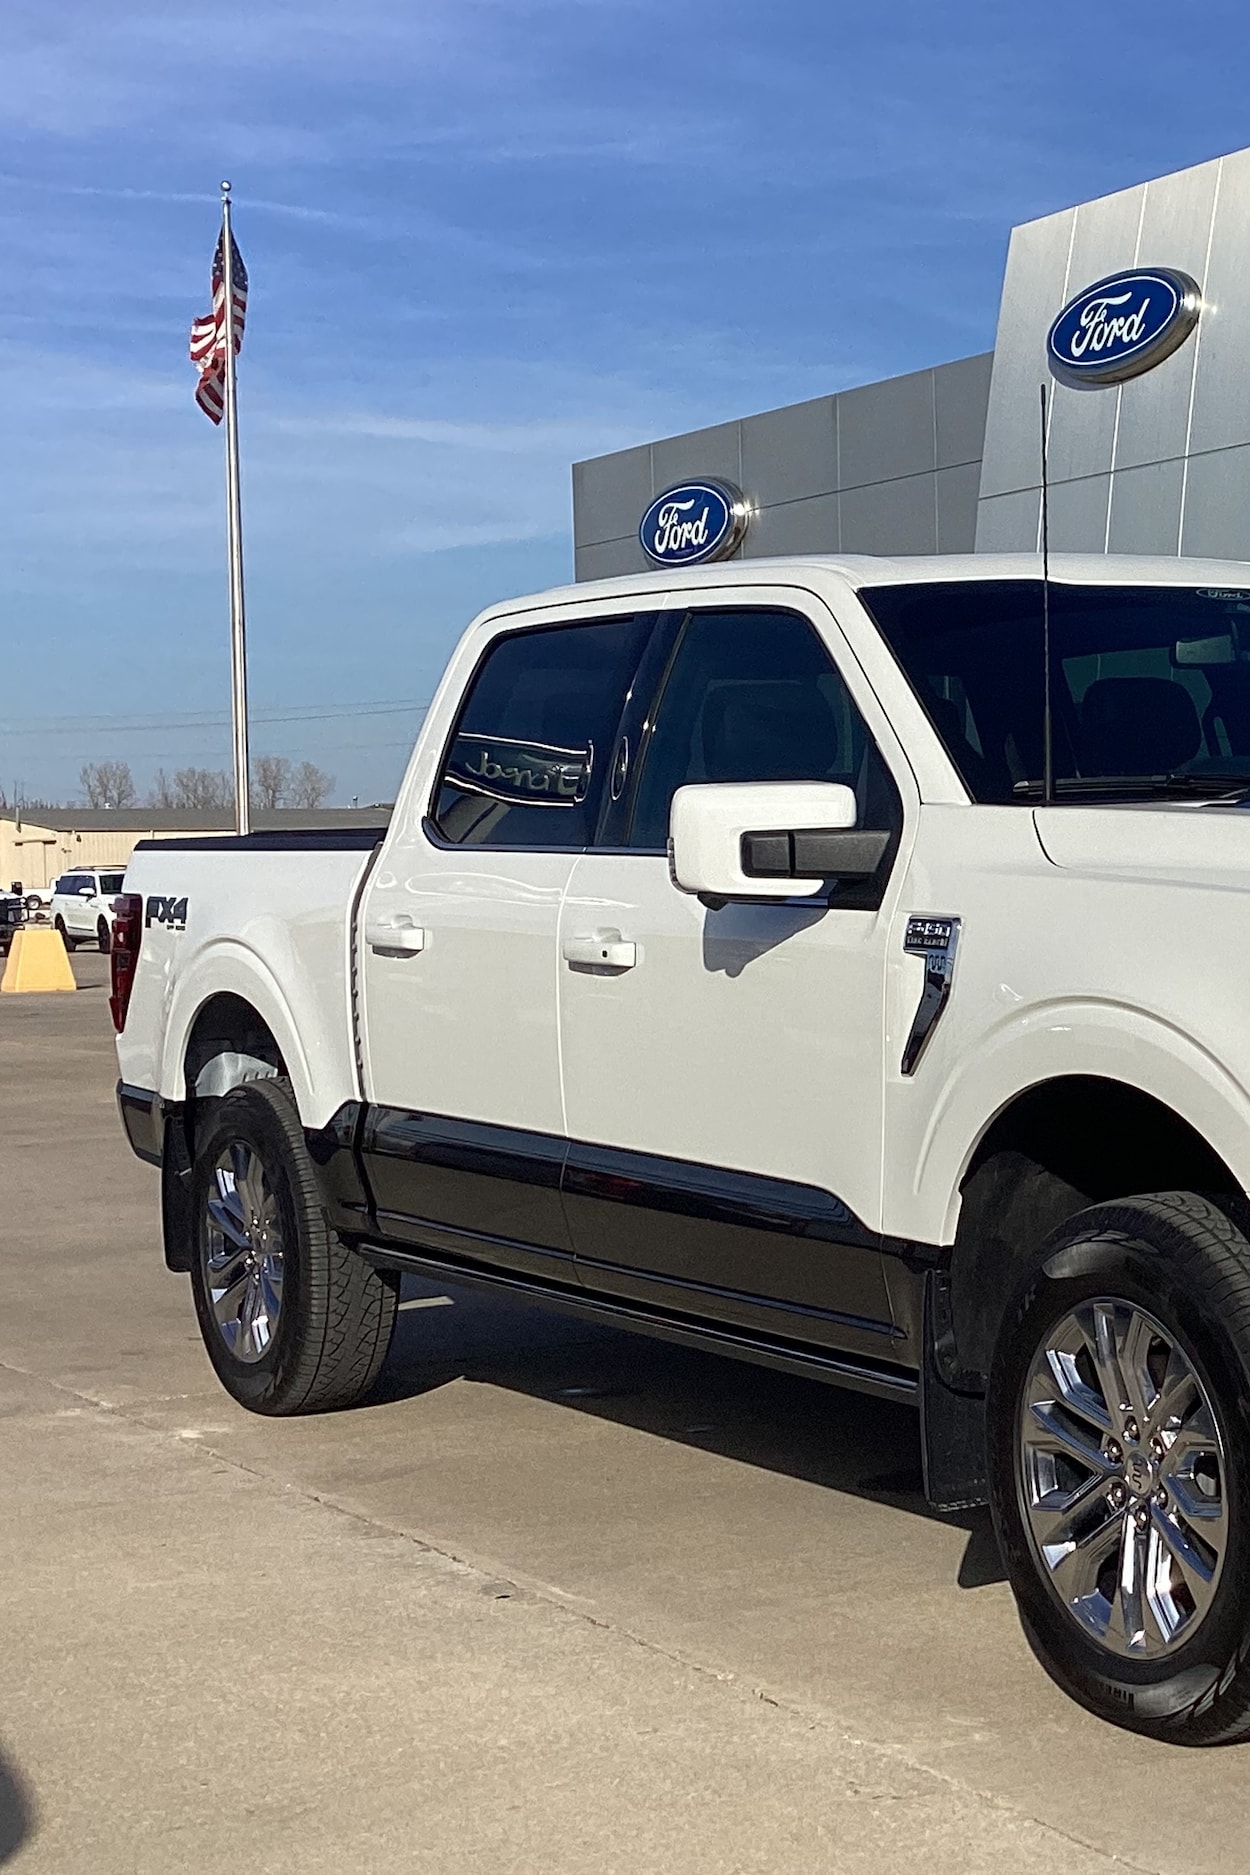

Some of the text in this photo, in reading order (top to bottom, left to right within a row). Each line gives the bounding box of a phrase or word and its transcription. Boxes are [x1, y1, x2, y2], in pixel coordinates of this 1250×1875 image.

[1070, 291, 1150, 357] Ford
[654, 499, 709, 553] Ford
[145, 896, 188, 928] FX4
